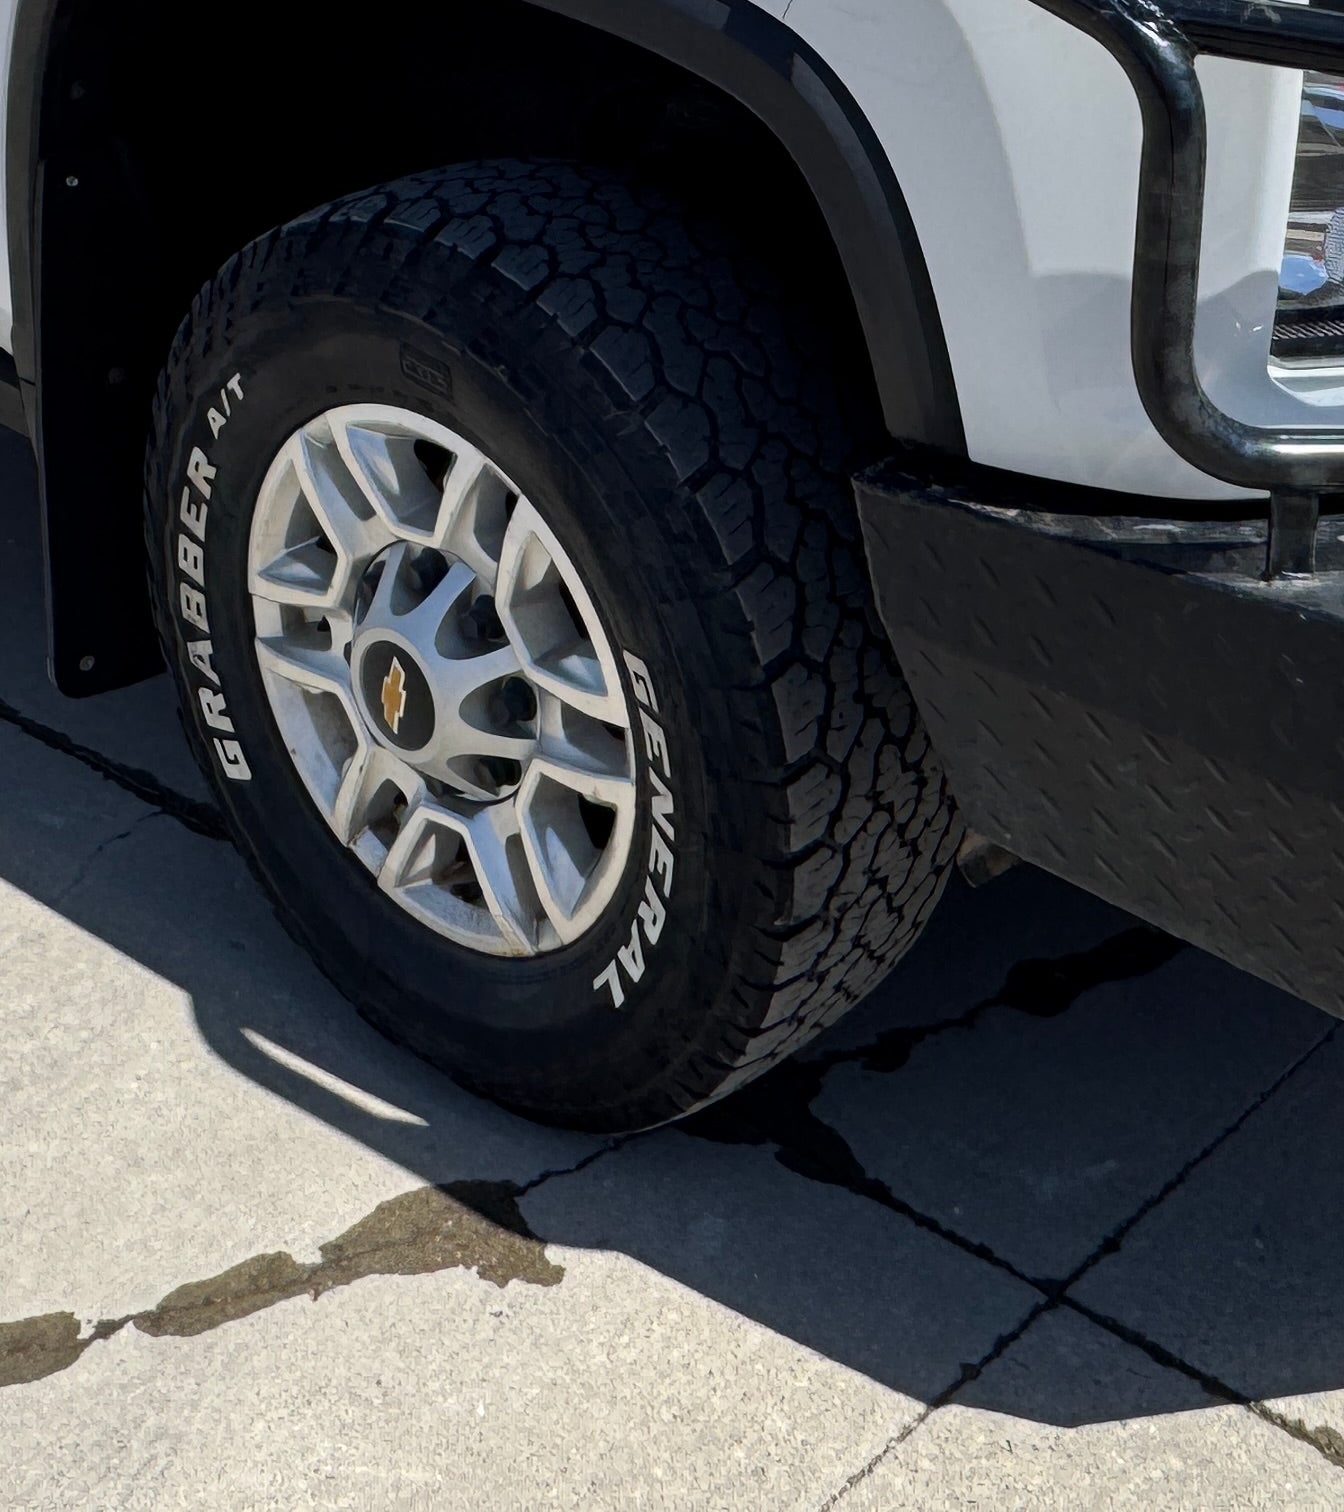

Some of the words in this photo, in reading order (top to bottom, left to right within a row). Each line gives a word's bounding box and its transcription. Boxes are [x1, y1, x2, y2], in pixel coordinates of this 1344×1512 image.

[206, 370, 245, 440] A/T
[177, 445, 253, 782] GRABBER
[592, 648, 677, 1009] GENERAL
